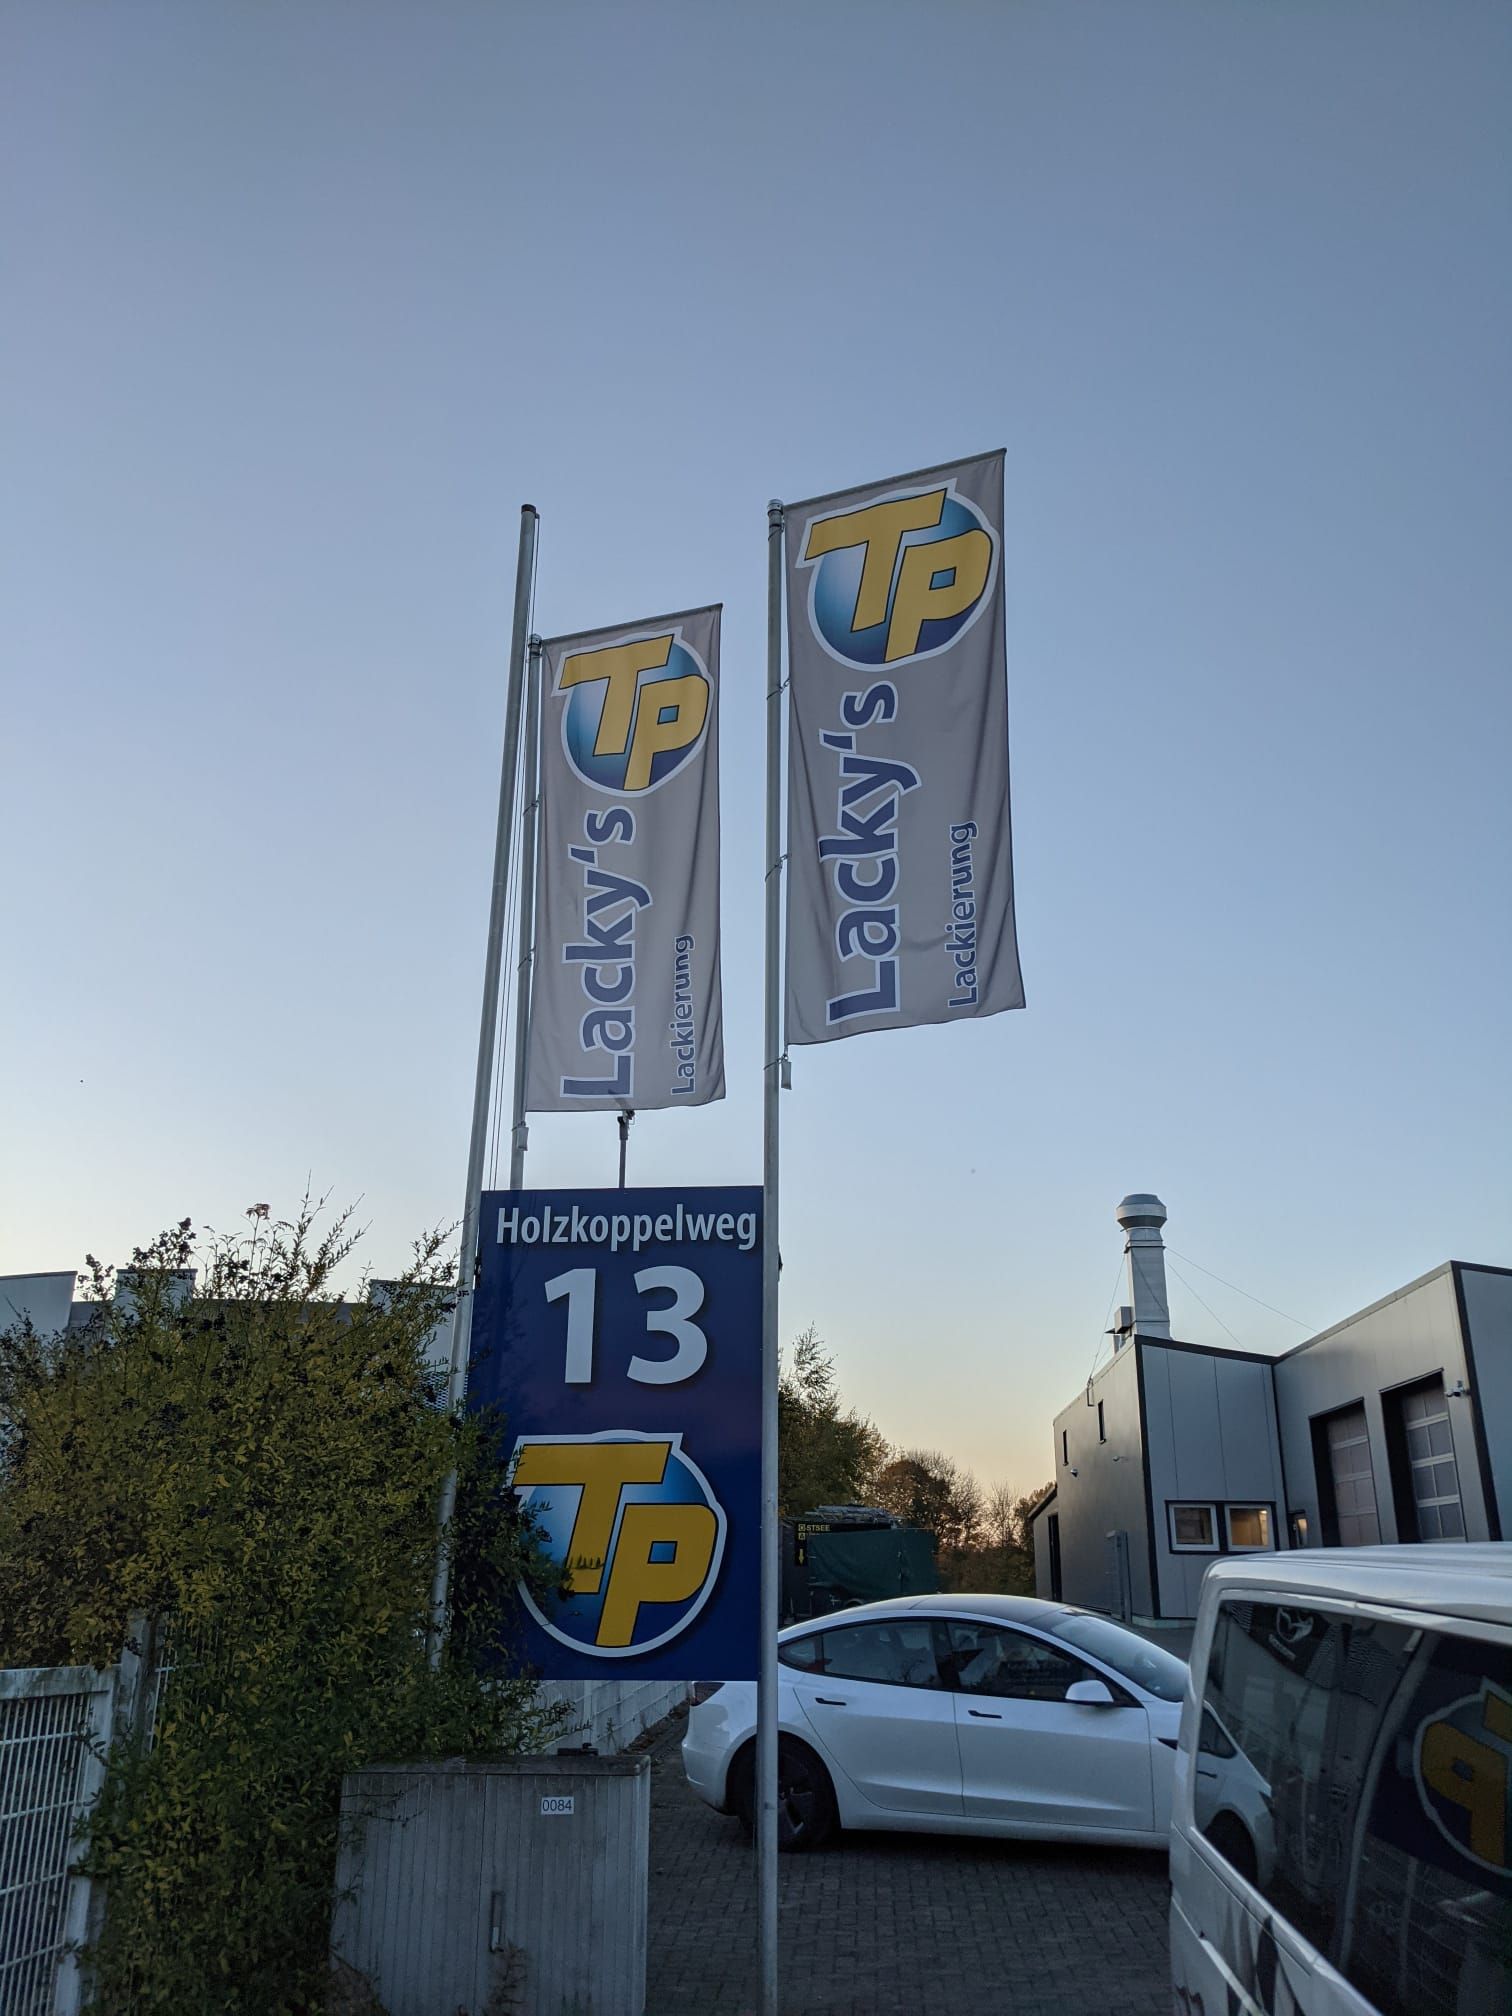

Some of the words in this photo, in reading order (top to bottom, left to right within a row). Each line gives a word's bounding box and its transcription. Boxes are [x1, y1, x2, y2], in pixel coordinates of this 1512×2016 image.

[803, 488, 993, 664] TP
[557, 633, 710, 791] TP
[817, 680, 921, 1025] Lacky's
[948, 820, 978, 1007] Lackierung
[561, 805, 650, 1097] Lacky's
[671, 934, 695, 1096] Lackierung
[496, 1203, 757, 1252] Holzkoppelweg
[544, 1265, 708, 1385] 13
[512, 1441, 718, 1649] TP
[542, 1799, 572, 1812] 0084
